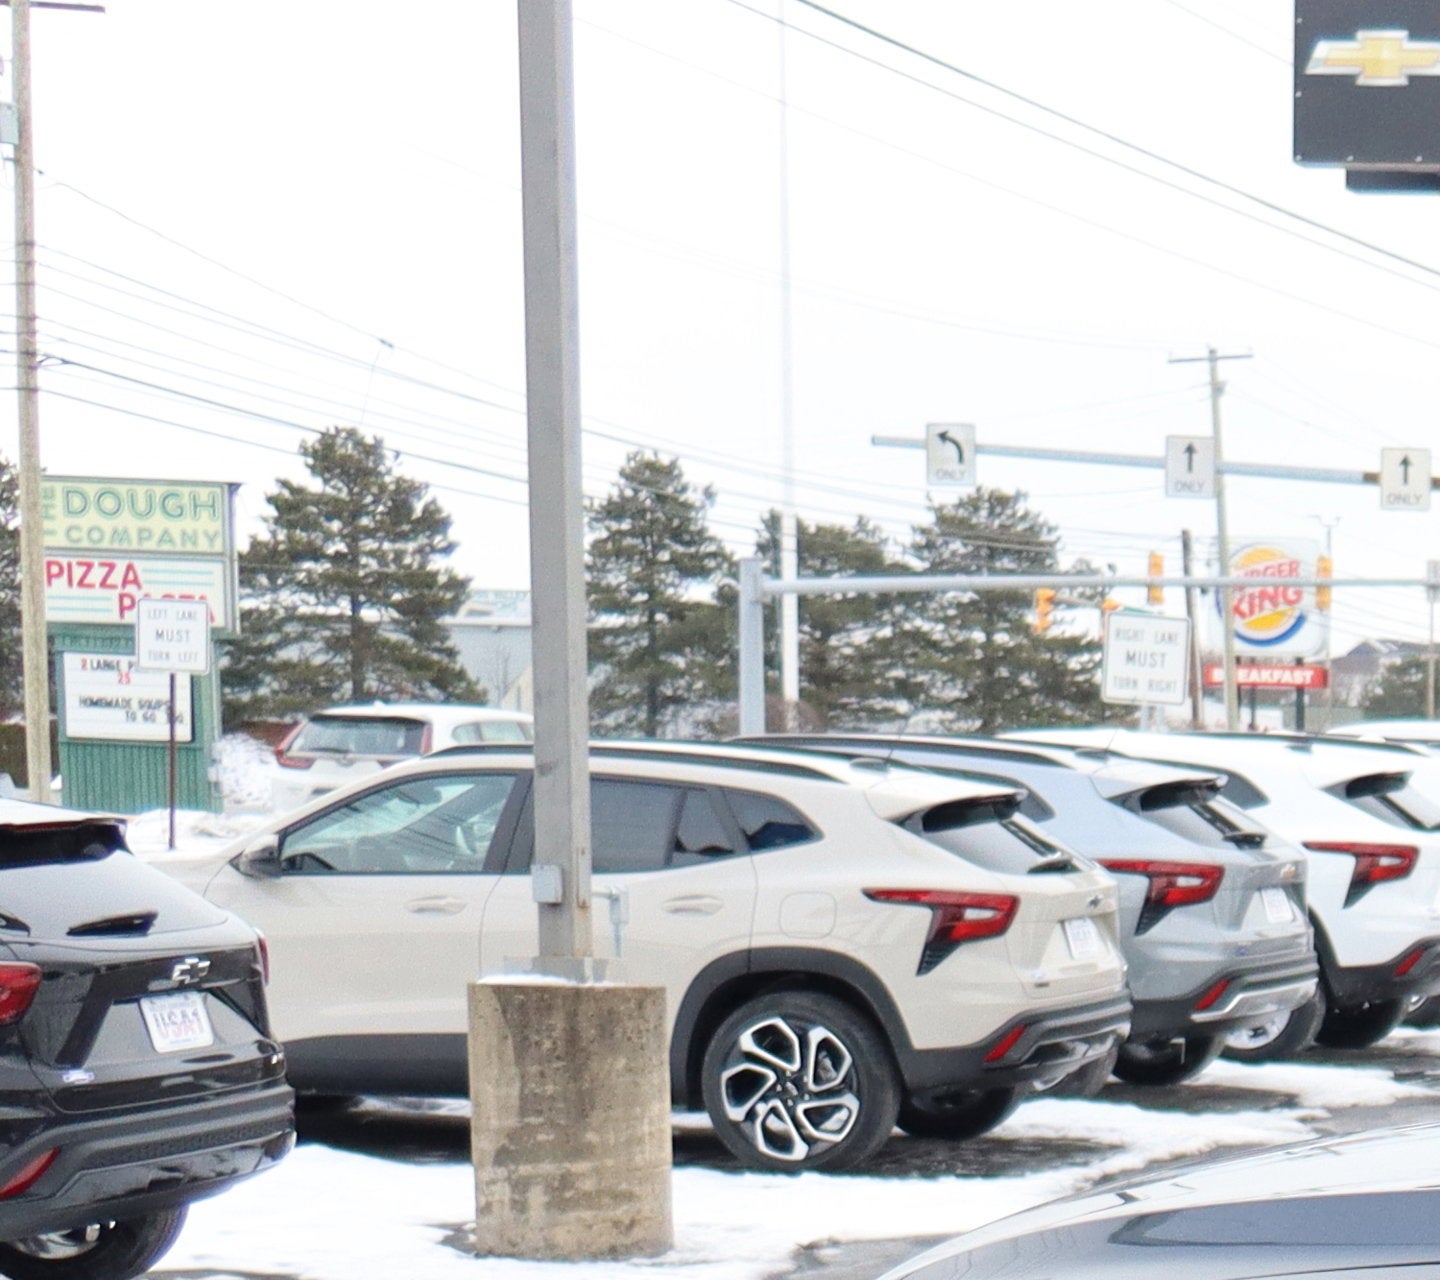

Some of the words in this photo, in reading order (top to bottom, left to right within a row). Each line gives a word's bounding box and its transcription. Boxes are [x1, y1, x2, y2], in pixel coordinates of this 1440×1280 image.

[935, 469, 966, 481] ONLY
[1174, 480, 1205, 493] ONLY
[63, 486, 221, 521] DOUGH
[1386, 492, 1423, 505] ONLY
[64, 525, 220, 549] COMPANY
[45, 560, 143, 591] PIZZA
[147, 608, 168, 620] LEFT
[175, 609, 198, 621] LANE
[155, 628, 191, 643] MUST
[1115, 628, 1145, 641] RIGHT
[1154, 630, 1180, 645] LANE
[148, 650, 170, 661] TURN
[178, 651, 199, 662] LEFT
[1125, 650, 1168, 668] MUST
[1211, 666, 1315, 685] BEAKFAST
[1113, 676, 1139, 690] TURN
[1148, 678, 1178, 693] RIGHT
